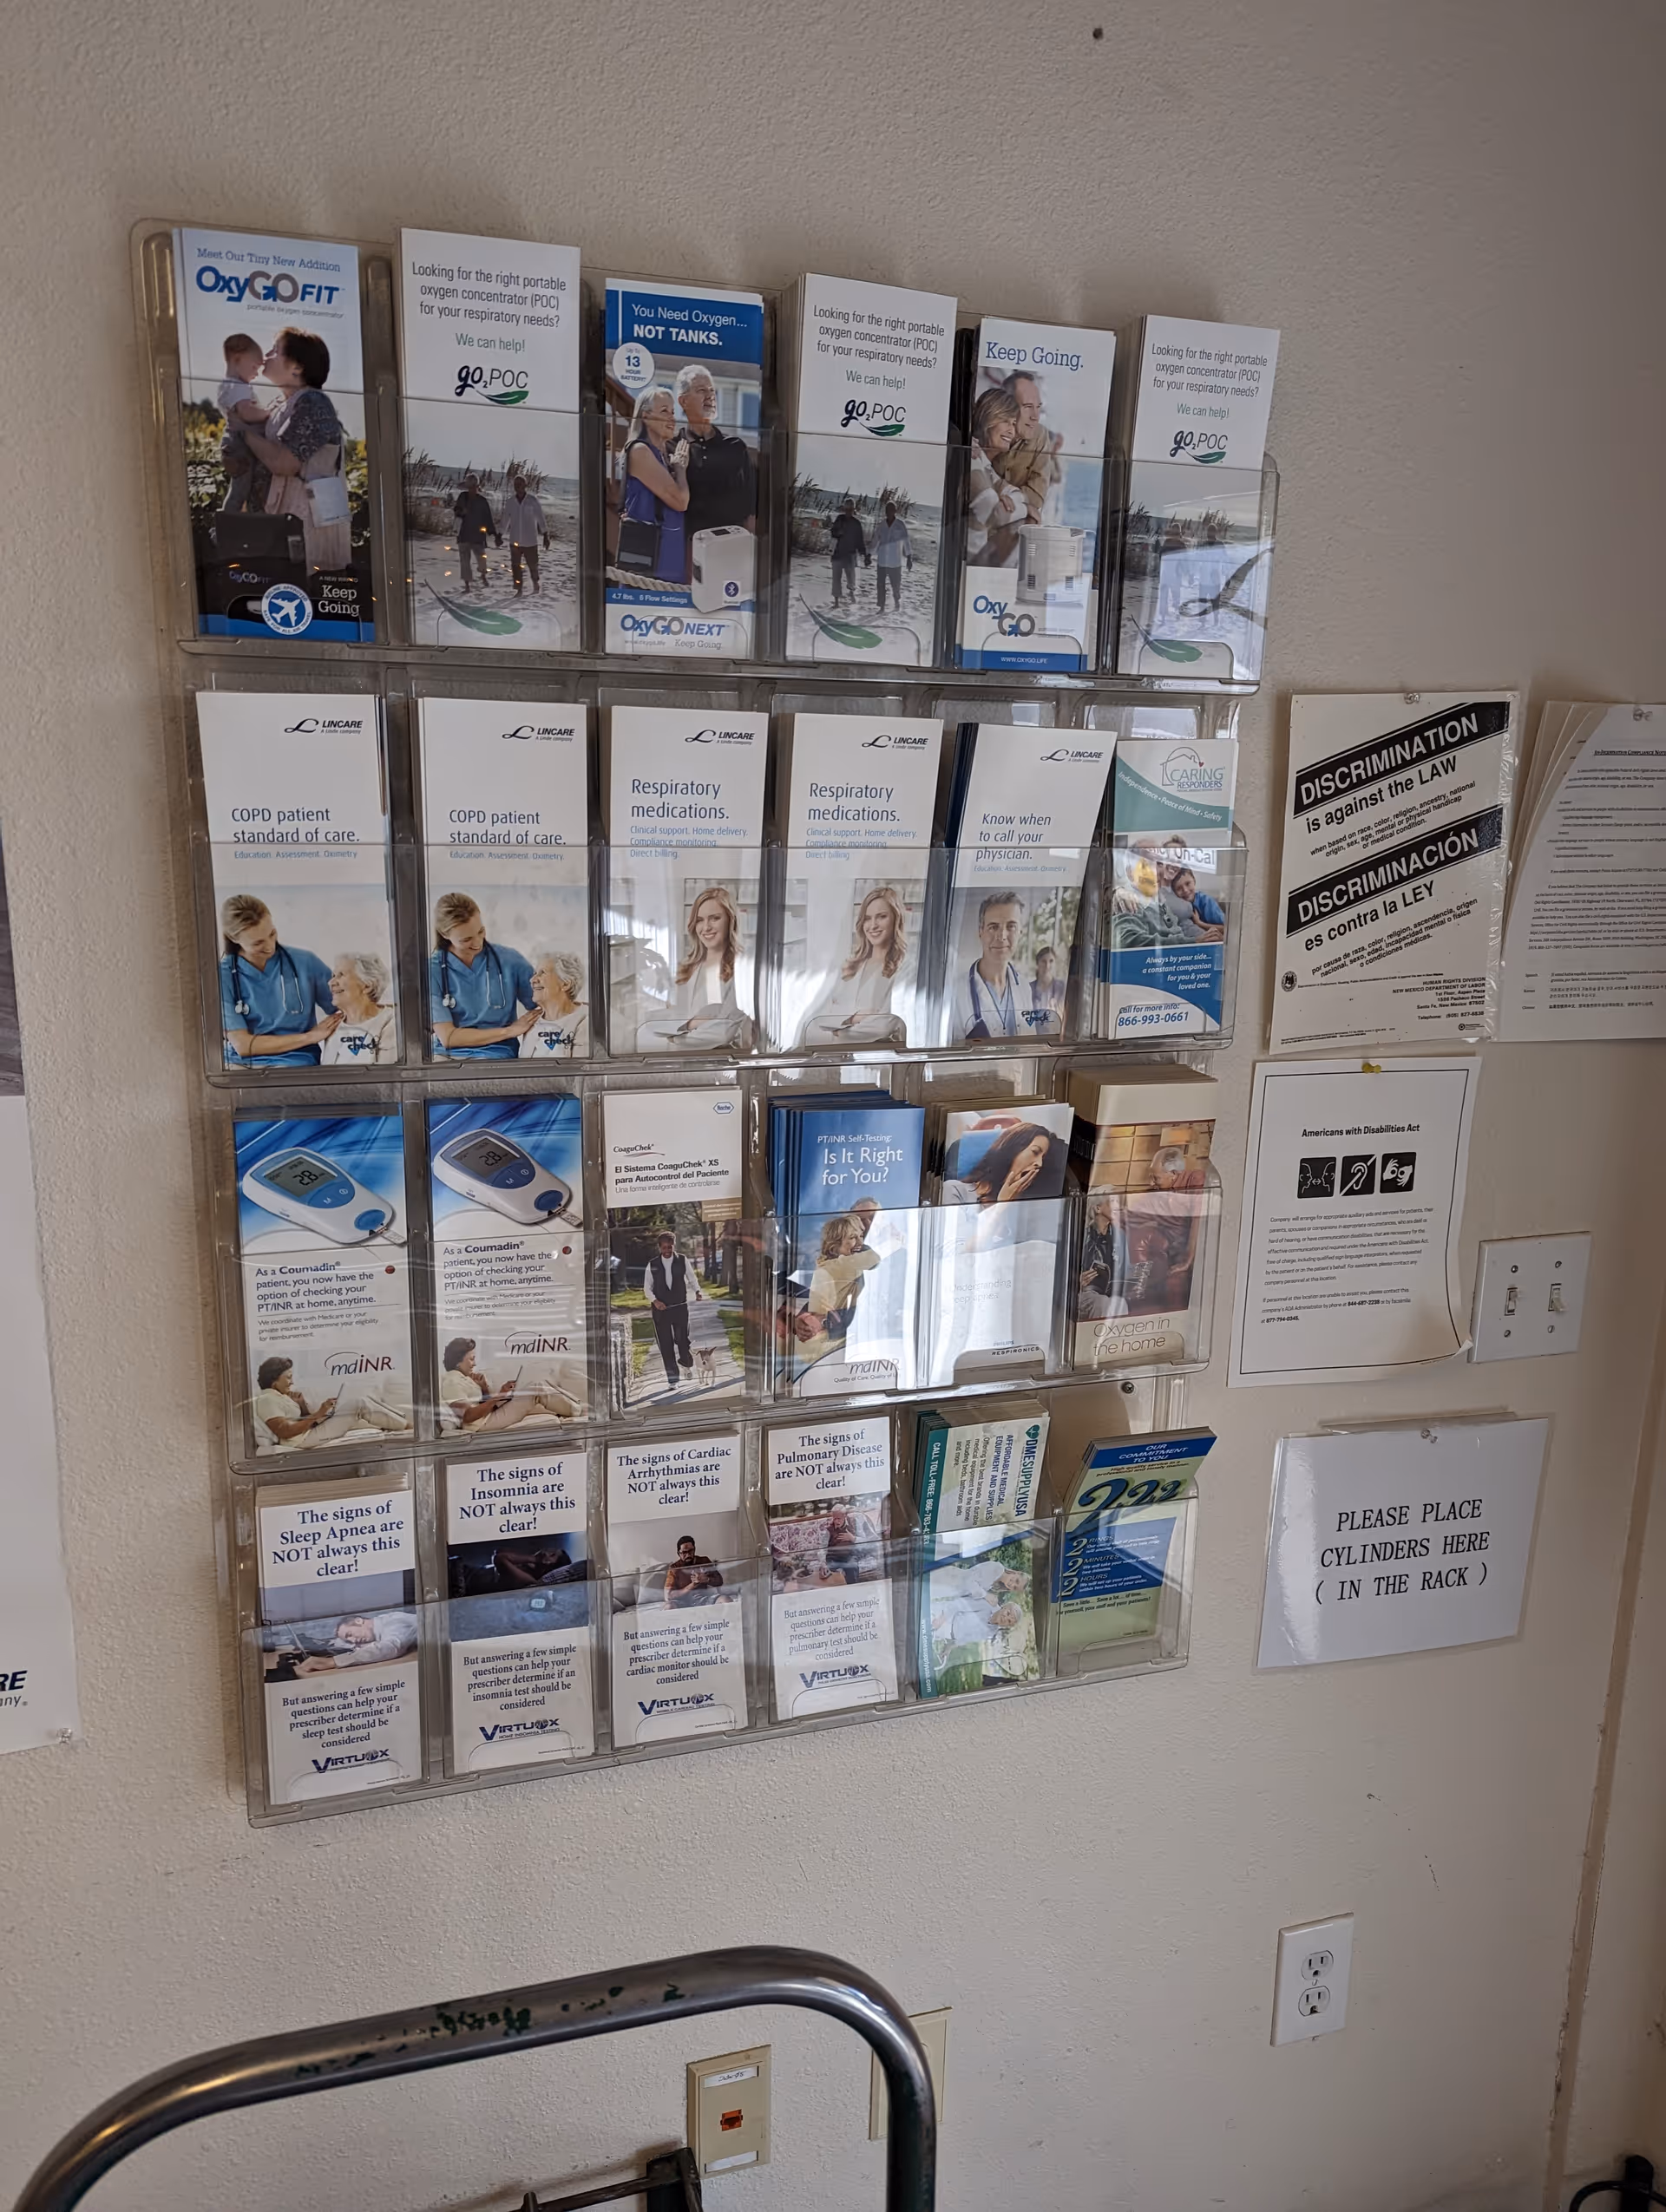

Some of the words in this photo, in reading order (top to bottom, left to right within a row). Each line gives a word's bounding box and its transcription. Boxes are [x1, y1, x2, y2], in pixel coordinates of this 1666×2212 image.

[196, 248, 222, 259] Meet
[226, 251, 245, 262] Our
[247, 252, 270, 266] Tiny
[272, 255, 296, 267] New
[299, 258, 341, 272] Addition
[412, 261, 454, 282] Looking
[457, 266, 472, 280] for
[476, 269, 493, 283] the
[495, 271, 521, 288] right
[522, 277, 566, 291] portable
[420, 285, 458, 300] oxygen
[461, 287, 528, 306] concentrator
[530, 293, 559, 311] (POC)
[419, 301, 435, 315] for
[437, 306, 462, 319] your
[463, 307, 521, 326] respiratory
[523, 313, 560, 328] needs?
[632, 304, 654, 317] You
[658, 307, 689, 321] Need
[692, 311, 748, 327] Oxygen...
[456, 332, 475, 347] We
[476, 337, 495, 350] can
[499, 337, 525, 354] help!
[633, 324, 666, 339] NOT
[669, 327, 724, 346] TANKS.
[625, 356, 640, 367] 13
[985, 341, 1026, 364] Keep
[1032, 346, 1084, 371] Going.
[1151, 343, 1184, 360] Looking
[1185, 347, 1197, 359] for
[1198, 349, 1212, 361] the
[1214, 350, 1233, 365] right
[1234, 354, 1268, 367] portable
[322, 585, 357, 600] Keep
[318, 600, 360, 617] Going
[322, 719, 363, 729] LINCARE
[718, 731, 755, 740] LINCARE
[1299, 712, 1479, 806] DISCRIMINATION
[1170, 767, 1224, 782] CARING
[1177, 780, 1223, 789] RESPONDERS
[632, 778, 721, 800] Respiratory
[1118, 771, 1158, 800] Independence
[1160, 796, 1177, 809] Peace
[1184, 806, 1200, 816] Mind
[1203, 810, 1222, 822] Safety
[1305, 815, 1321, 834] is
[1323, 789, 1385, 831] against
[1387, 776, 1415, 800] the
[1417, 756, 1459, 786] LAW
[231, 808, 272, 822] COPD
[277, 807, 331, 825] patient
[631, 801, 730, 820] medications.
[981, 813, 1015, 825] Know
[1019, 813, 1052, 826] when
[1310, 843, 1328, 856] when
[1328, 835, 1348, 848] based
[1357, 825, 1374, 835] race,
[1374, 816, 1393, 828] color,
[1393, 805, 1419, 823] religion,
[1419, 793, 1449, 809] ancestry,
[1449, 782, 1476, 796] national
[233, 828, 299, 843] standard
[305, 827, 319, 842] of
[325, 830, 360, 842] care.
[979, 830, 990, 842] to
[994, 830, 1014, 842] call
[1017, 833, 1044, 845] your
[975, 847, 1033, 861] physician.
[1297, 828, 1479, 924] DISCRIMINACIÓN
[1304, 936, 1323, 952] es
[1327, 909, 1380, 942] contra
[1381, 900, 1399, 919] la
[1402, 880, 1436, 909] LEY
[1118, 1011, 1189, 1027] 866-993-0661
[817, 1135, 846, 1143] PT/INR
[848, 1134, 893, 1143] Self-Testing:
[1301, 1127, 1343, 1138] Americans
[1345, 1126, 1362, 1135] with
[1362, 1124, 1406, 1135] Disabilities
[1406, 1123, 1420, 1132] Act
[624, 1164, 656, 1173] Sistema
[708, 1158, 719, 1167] XS
[823, 1148, 837, 1165] Is
[842, 1148, 854, 1164] It
[860, 1145, 903, 1167] Right
[615, 1176, 633, 1185] para
[635, 1172, 681, 1182] Autocontrol
[696, 1168, 730, 1178] Paciente
[822, 1168, 848, 1186] for
[850, 1167, 889, 1184] You?
[255, 1267, 269, 1278] As
[256, 1279, 292, 1291] patient,
[292, 1278, 311, 1288] you
[336, 1273, 357, 1282] have
[358, 1271, 375, 1280] the
[257, 1291, 288, 1302] option
[291, 1289, 302, 1299] of
[303, 1286, 344, 1298] checking
[344, 1286, 367, 1296] your
[257, 1301, 293, 1313] PT/INR
[307, 1299, 337, 1308] home,
[338, 1295, 377, 1306] anytime.
[1093, 1320, 1155, 1337] Oxygen
[1158, 1317, 1170, 1330] in
[1121, 1337, 1166, 1352] home
[777, 1449, 840, 1464] Pulmonary
[842, 1443, 882, 1457] Disease
[1001, 1434, 1014, 1476] AFFORDABLE
[1118, 1447, 1189, 1460] COMMITMENT
[1148, 1454, 1170, 1463] YOU
[997, 1476, 1007, 1507] MEDICAL
[297, 1509, 329, 1525] The
[332, 1506, 372, 1523] signs
[376, 1500, 393, 1515] of
[1336, 1505, 1410, 1532] PLEASE
[1421, 1499, 1483, 1523] PLACE
[279, 1530, 322, 1546] Sleep
[325, 1526, 377, 1541] Apnea
[380, 1520, 404, 1533] are
[272, 1547, 313, 1565] NOT
[317, 1542, 368, 1560] always
[371, 1536, 401, 1551] this
[1321, 1537, 1430, 1567] CYLINDERS
[1441, 1531, 1491, 1555] HERE
[316, 1559, 359, 1578] clear!
[1336, 1578, 1362, 1601] IN
[1373, 1574, 1410, 1597] THE
[1420, 1567, 1470, 1591] RACK
[282, 1697, 299, 1707] But
[301, 1690, 349, 1705] answering
[357, 1686, 374, 1696] few
[375, 1679, 406, 1692] simple
[321, 1732, 371, 1749] considered
